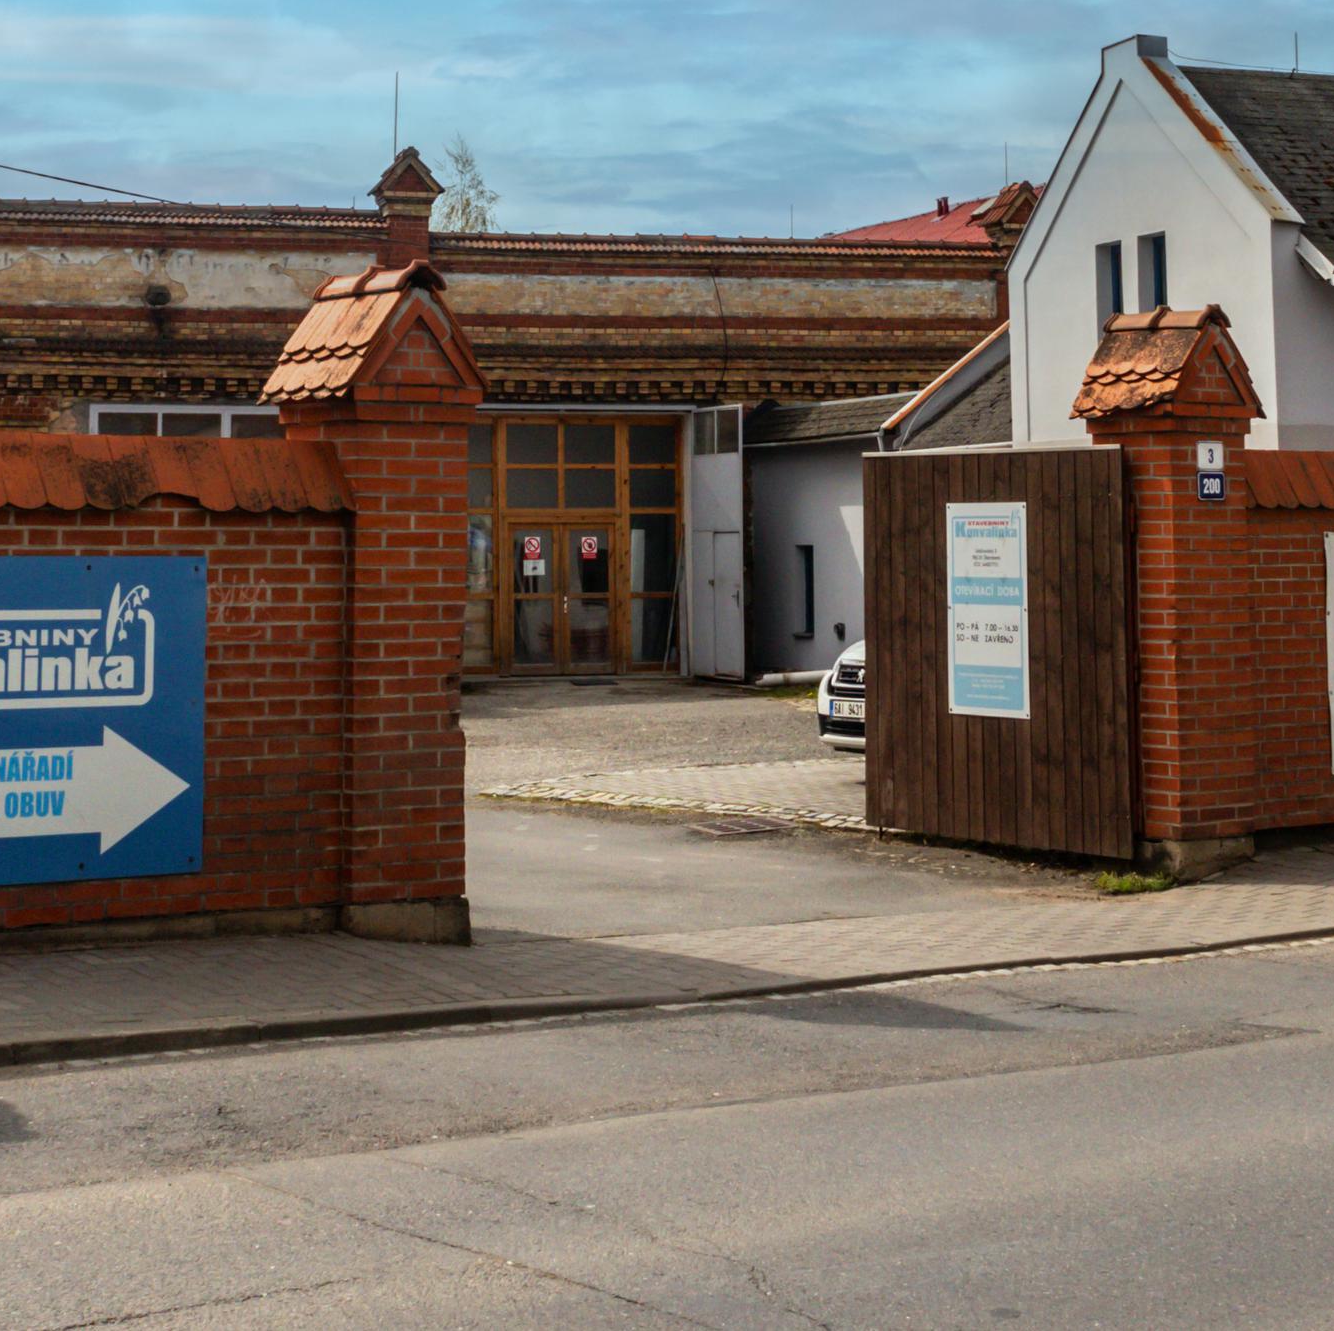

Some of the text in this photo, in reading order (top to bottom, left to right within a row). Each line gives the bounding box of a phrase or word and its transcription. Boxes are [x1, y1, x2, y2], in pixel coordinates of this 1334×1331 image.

[1208, 448, 1214, 464] 3
[1203, 478, 1221, 494] 200
[4, 790, 66, 817] OBUV
